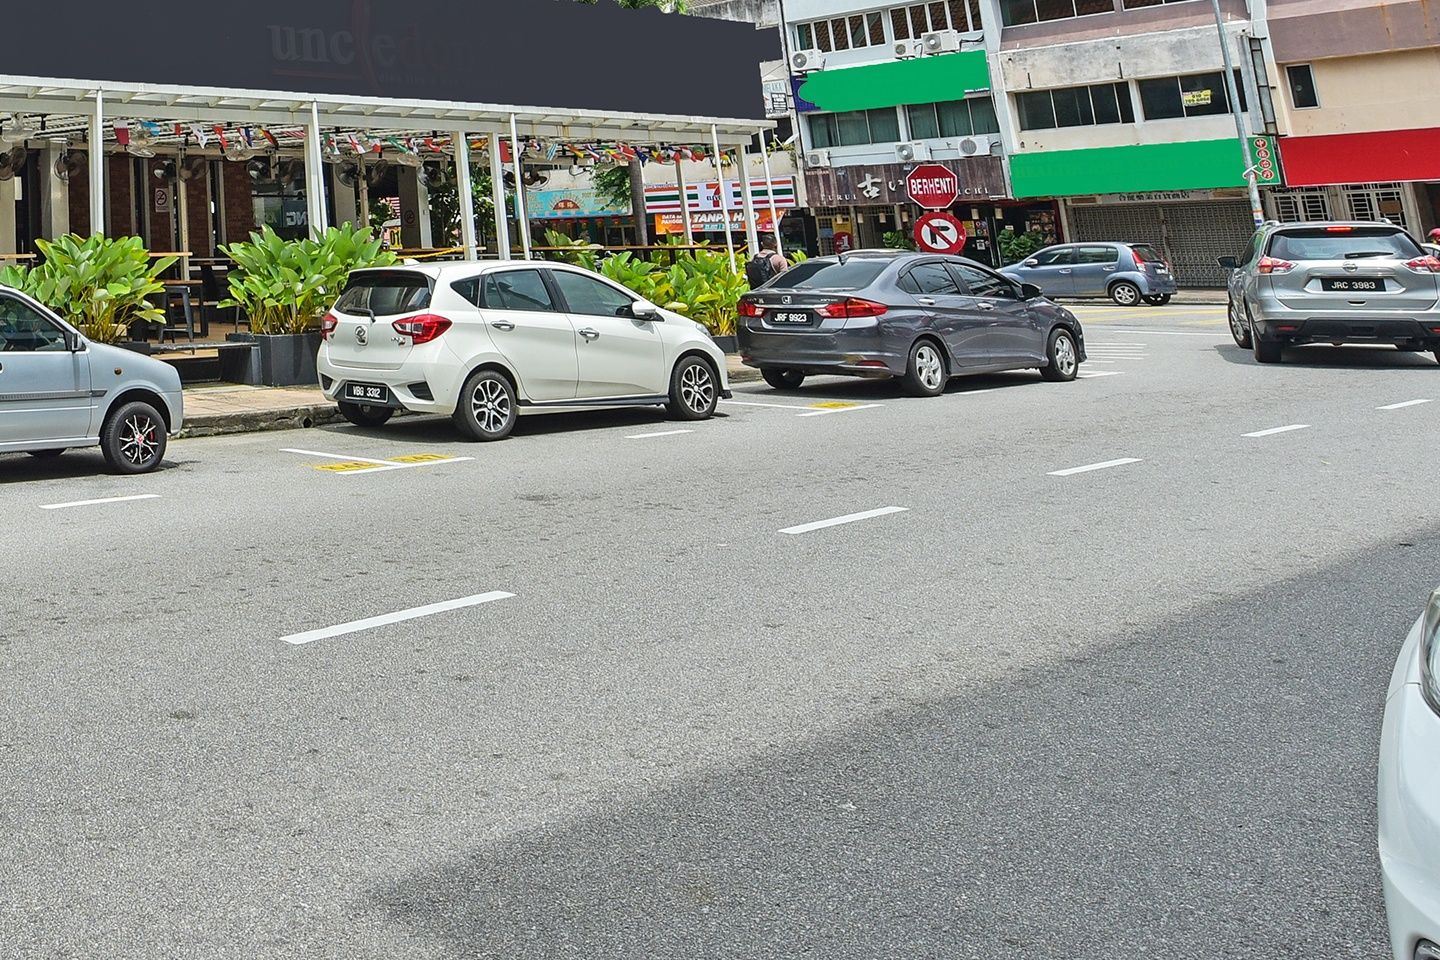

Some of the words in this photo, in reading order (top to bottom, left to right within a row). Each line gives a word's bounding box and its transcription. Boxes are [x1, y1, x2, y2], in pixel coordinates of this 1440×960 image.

[910, 178, 955, 195] BERHENTI
[774, 313, 788, 322] JRF
[789, 313, 807, 322] 9923
